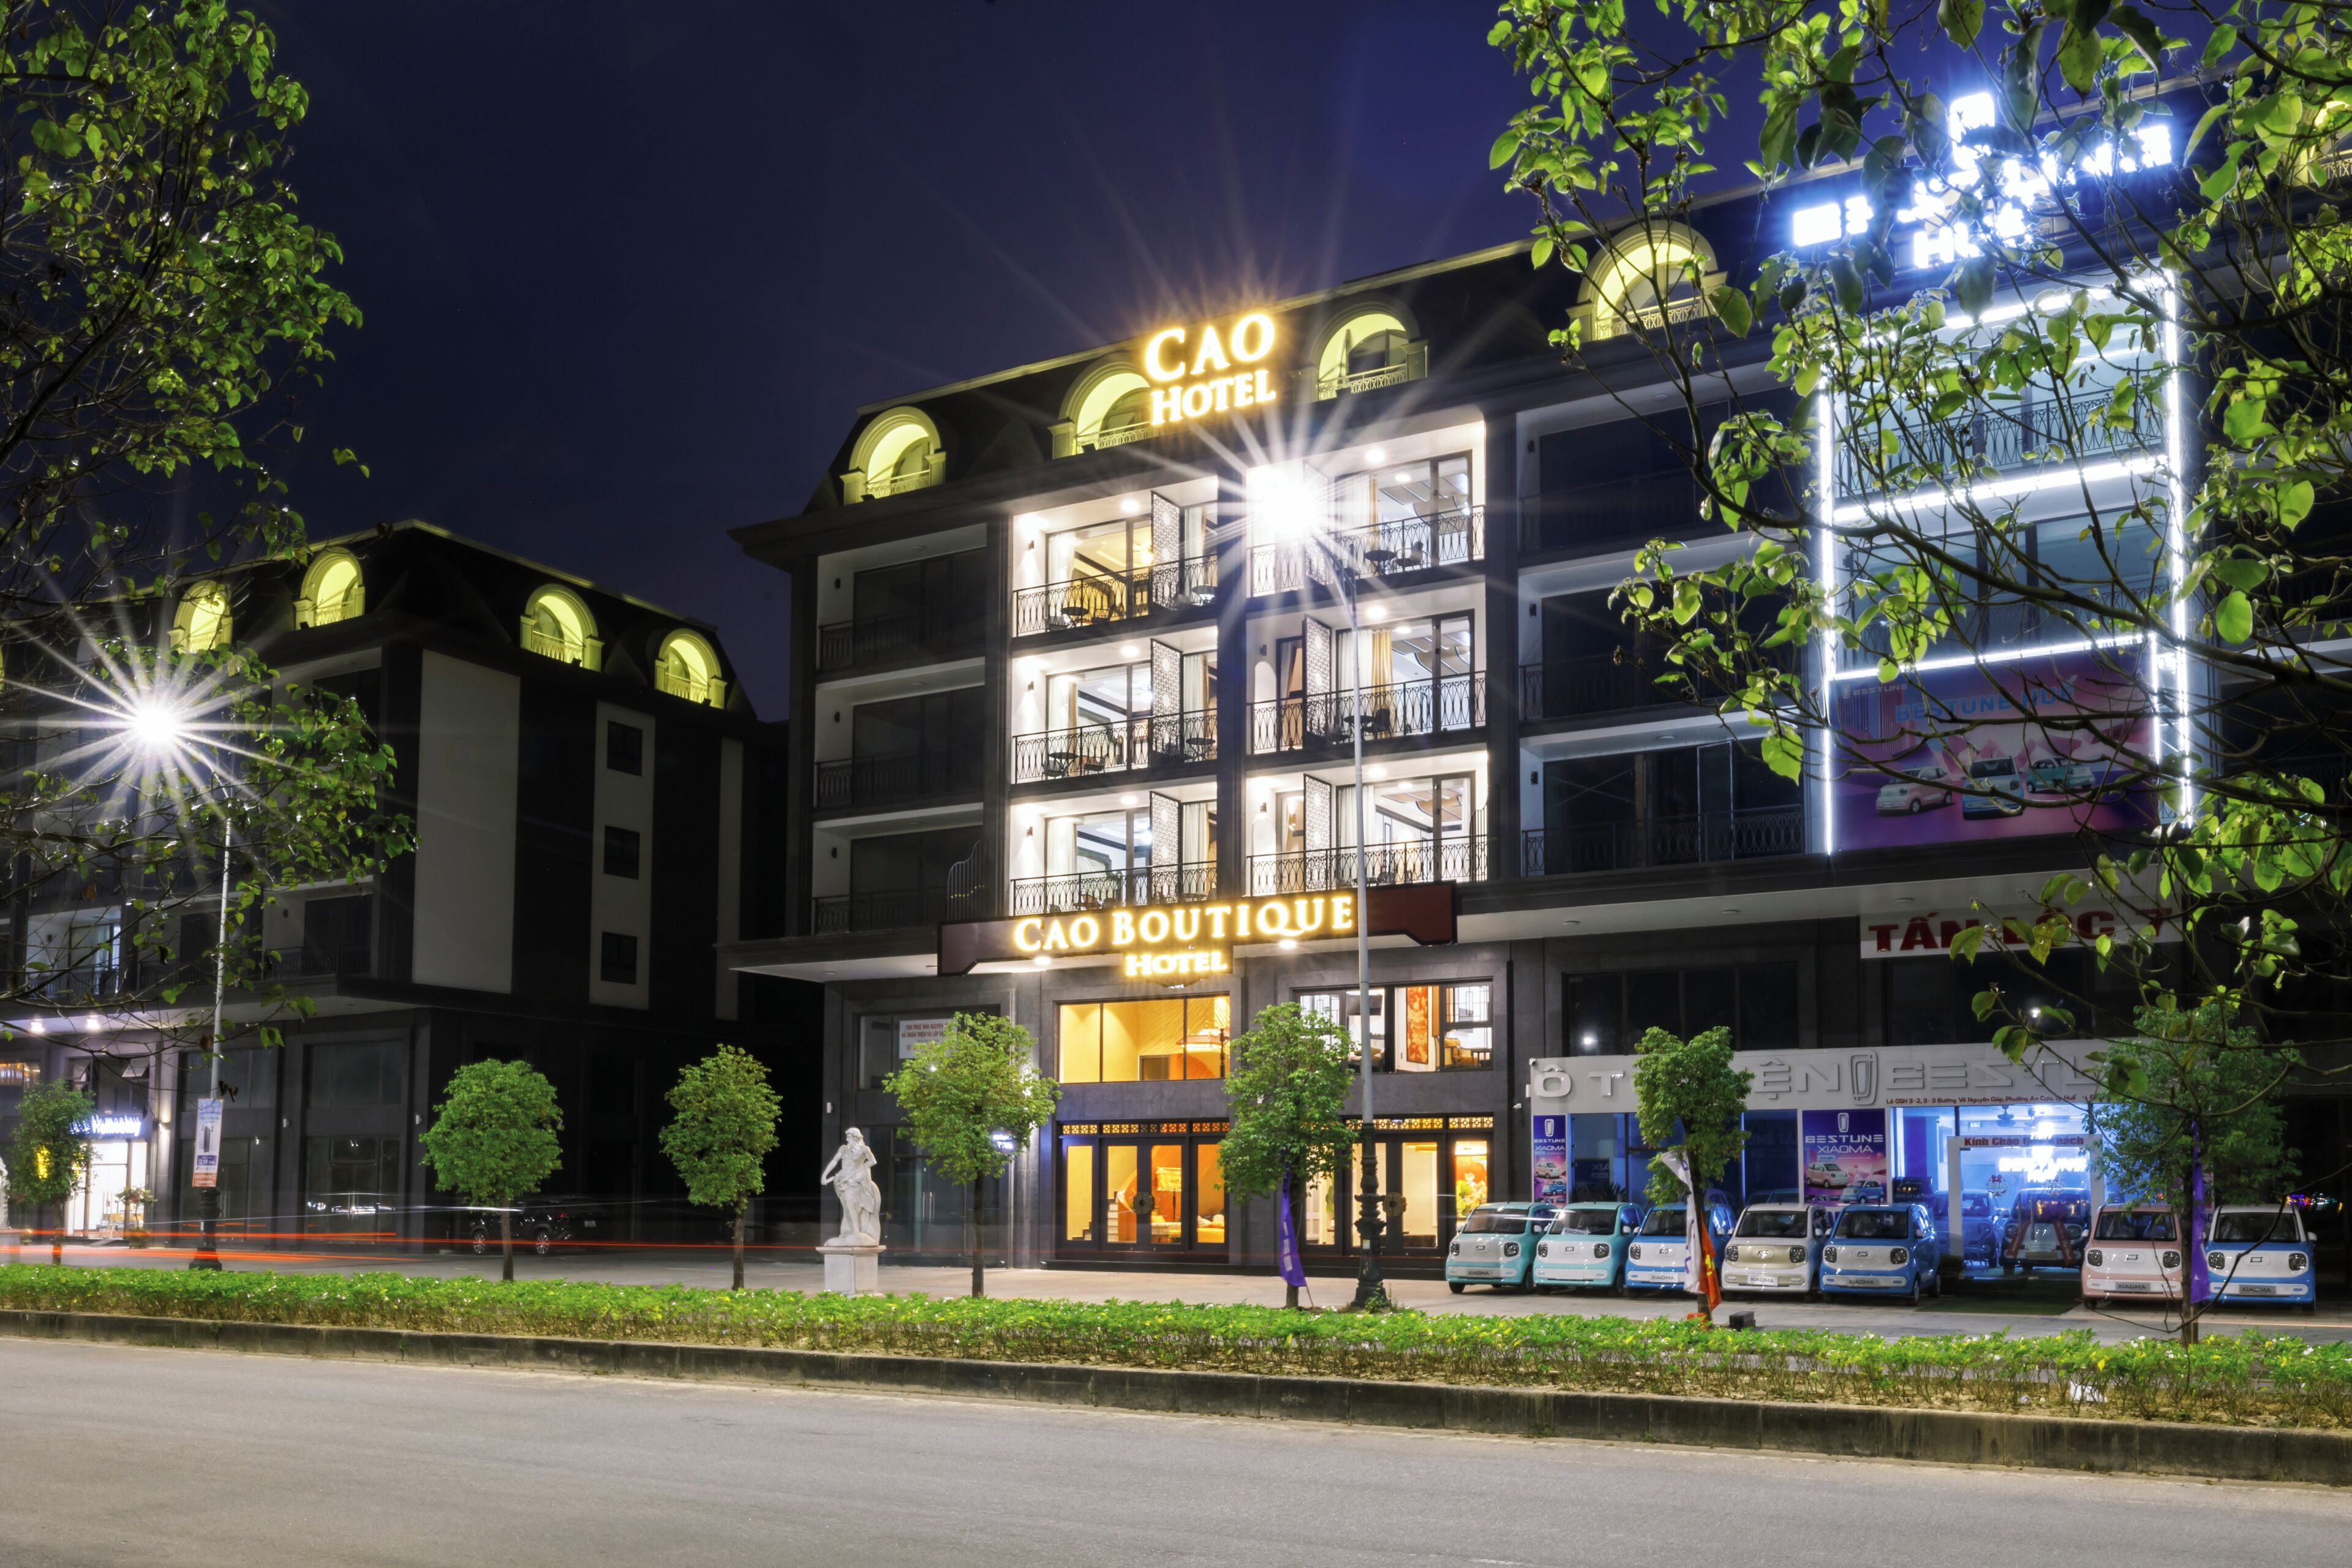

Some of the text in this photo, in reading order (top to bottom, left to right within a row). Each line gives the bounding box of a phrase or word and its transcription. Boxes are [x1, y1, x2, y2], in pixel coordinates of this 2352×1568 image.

[1145, 314, 1275, 381] CAO
[1151, 370, 1276, 425] HOTEL
[1853, 684, 1908, 695] BESTUNE
[1896, 693, 2013, 723] BESTUNE
[1014, 896, 1353, 951] CAO BOUTIQUE
[1125, 951, 1228, 976] HOTEL
[1534, 1065, 1572, 1098] Ô
[1806, 1134, 1883, 1144] BESTUNE
[1818, 1145, 1874, 1153] XIAOMA
[1964, 1137, 1989, 1146] Kính
[1992, 1136, 2020, 1146] Chào
